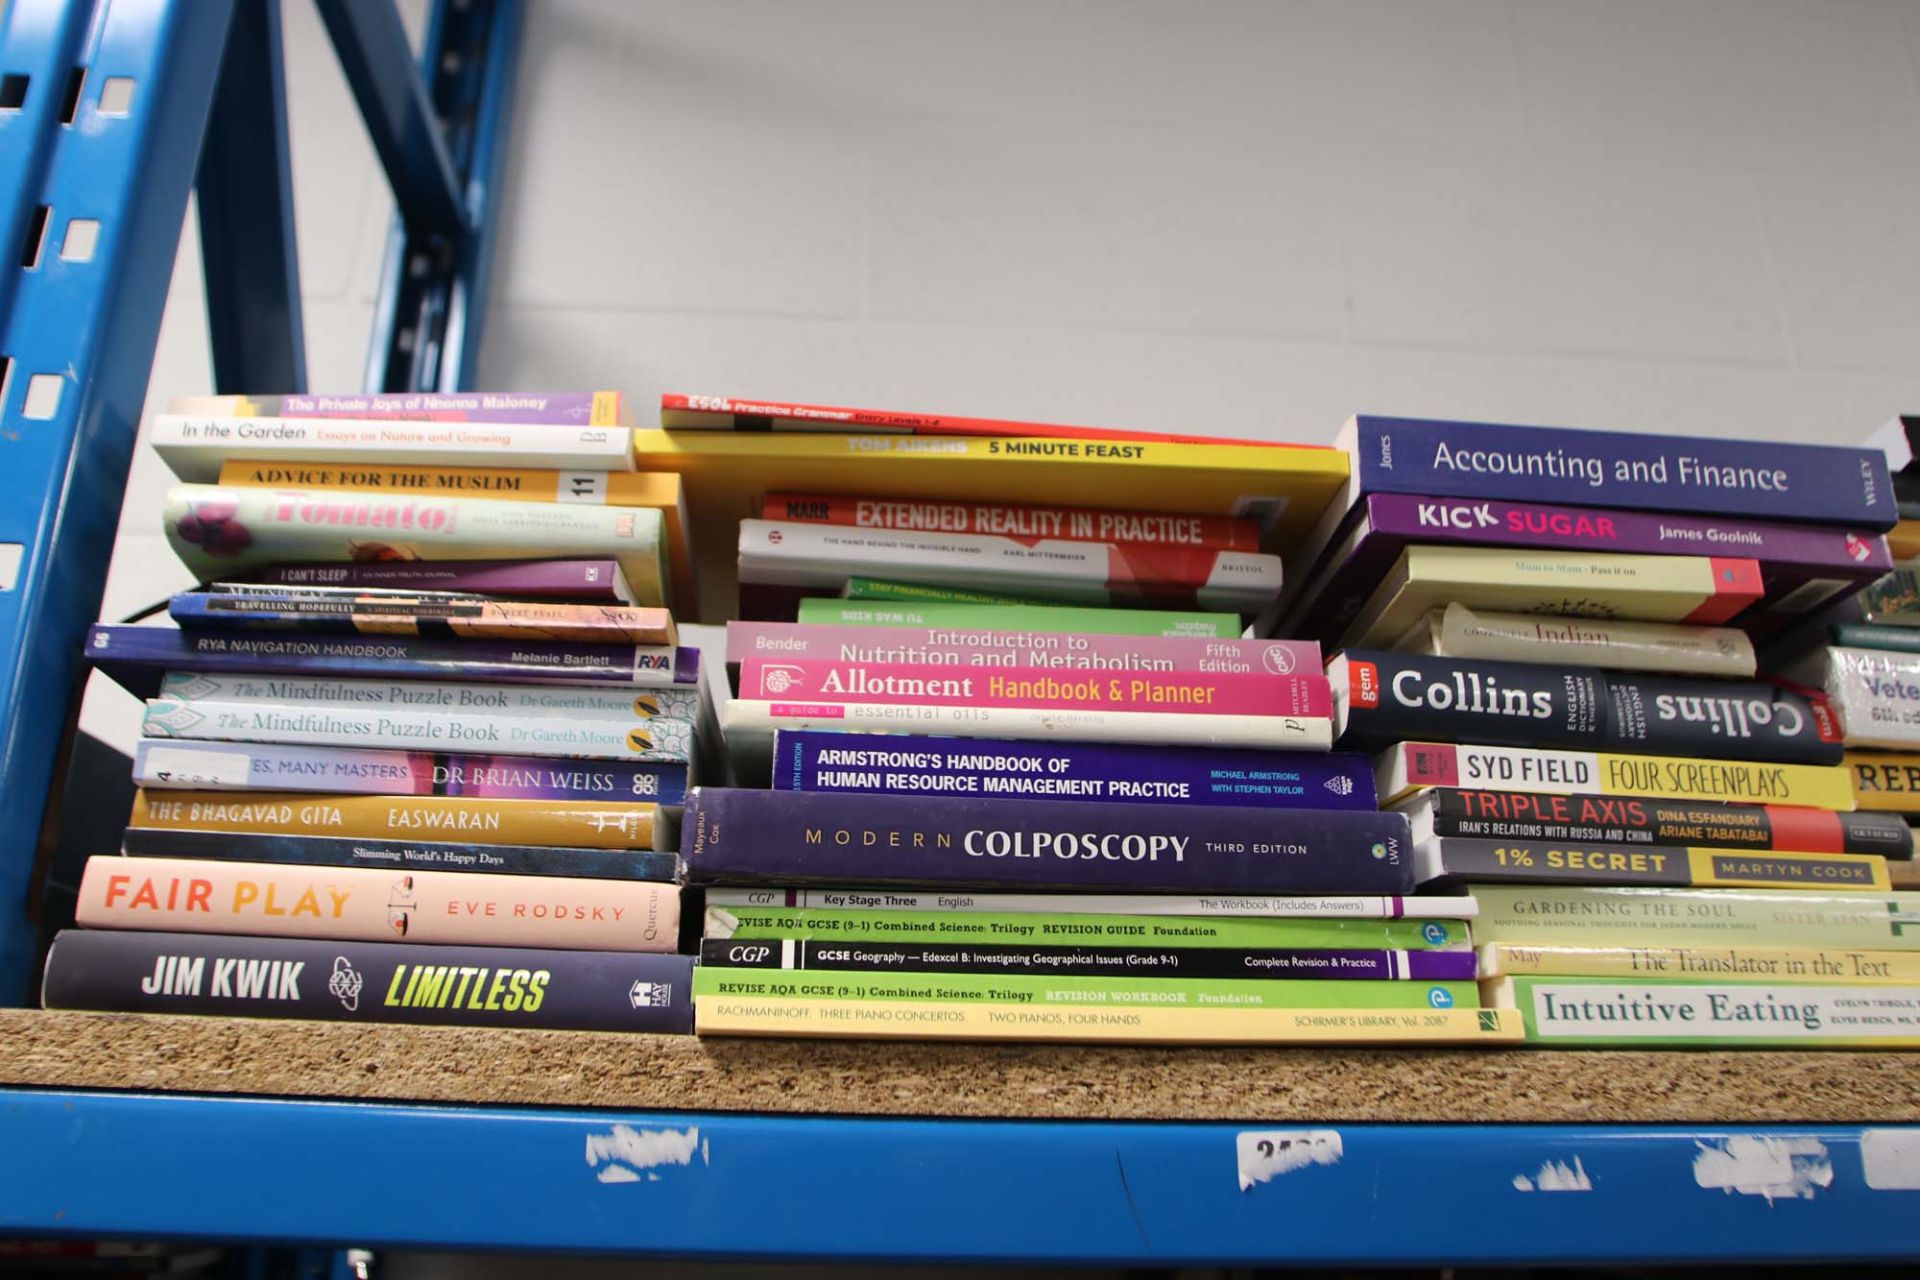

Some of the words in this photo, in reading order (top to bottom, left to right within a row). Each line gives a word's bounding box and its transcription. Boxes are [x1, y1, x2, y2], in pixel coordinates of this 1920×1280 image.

[288, 397, 316, 411] The
[319, 398, 368, 411] Private
[371, 398, 401, 412] Joys
[405, 397, 420, 410] of
[424, 397, 478, 411] Nnenna
[482, 396, 548, 412] Maloney
[688, 395, 731, 411] ESOL
[794, 407, 851, 420] Grammar
[1433, 442, 1603, 486] Accounting
[1615, 456, 1667, 483] and
[1678, 458, 1789, 491] Finance
[250, 470, 333, 485] ADVICE
[338, 471, 381, 487] FOR
[390, 473, 429, 487] THE
[436, 474, 521, 491] MUSLIM
[856, 502, 967, 530] EXTENDED
[975, 507, 1062, 536] REALITY
[1071, 511, 1092, 538] IN
[1100, 514, 1203, 544] PRACTICE
[1418, 503, 1499, 529] KICK
[1507, 510, 1617, 539] SUGAR
[1660, 524, 1703, 541] James
[1707, 528, 1762, 545] Goolnik
[235, 600, 294, 611] TRAVELLING
[299, 602, 355, 613] HOPEFULLY
[197, 639, 226, 651] RYA
[230, 641, 318, 655] NAVIGATION
[323, 644, 408, 658] HANDBOOK
[755, 637, 809, 651] Bender
[927, 629, 1066, 650] Introduction
[1068, 635, 1088, 650] to
[512, 652, 560, 663] Melanie
[564, 654, 609, 665] Bartlett
[840, 643, 959, 664] Nutrition
[970, 650, 1017, 668] and
[1029, 650, 1174, 672] Metabolism
[1206, 644, 1240, 658] Fifth
[637, 655, 670, 670] RYA
[1199, 659, 1250, 673] Edition
[234, 682, 262, 698] The
[266, 683, 383, 702] Mindfulness
[389, 688, 452, 706] Puzzle
[460, 689, 508, 708] Book
[519, 694, 532, 707] Dr
[536, 695, 584, 709] Gareth
[587, 698, 631, 710] Moore
[819, 668, 973, 697] Allotment
[989, 676, 1101, 701] Handbook
[1109, 679, 1123, 701] &
[1131, 681, 1215, 704] Planner
[1392, 670, 1553, 719] Collins
[855, 706, 940, 720] essential
[952, 709, 989, 721] oils
[1655, 694, 1804, 737] Collins
[278, 760, 328, 775] MANY
[334, 761, 407, 779] MASTERS
[817, 749, 942, 769] ARMSTRONG'S
[946, 754, 1043, 773] HANDBOOK
[1048, 758, 1070, 772] OF
[1467, 755, 1513, 779] SYD
[1522, 758, 1589, 784] FIELD
[432, 766, 464, 785] DR
[473, 767, 541, 788] BRIAN
[550, 771, 614, 791] WEISS
[817, 772, 880, 788] HUMAN
[885, 772, 977, 791] RESOURCE
[983, 776, 1103, 795] MANAGEMENT
[1109, 781, 1190, 798] PRACTICE
[1211, 770, 1247, 780] MICHAEL
[1248, 770, 1300, 782] ARMSTRONG
[1609, 759, 1663, 793] FOUR
[1668, 764, 1790, 799] SCREENPLAYS
[1211, 783, 1231, 793] WITH
[1234, 784, 1271, 794] STEPHEN
[1273, 785, 1304, 795] TAYLOR
[150, 801, 181, 821] THE
[190, 802, 291, 824] BHAGAVAD
[300, 806, 342, 825] GITA
[388, 808, 500, 829] EASWARAN
[1458, 791, 1571, 822] TRIPLE
[1581, 797, 1649, 825] AXIS
[1657, 810, 1686, 822] DINA
[1689, 811, 1760, 826] ESFANDIARY
[1459, 821, 1490, 834] IRAN'S
[1492, 822, 1541, 837] RELATIONS
[1545, 825, 1567, 838] WITH
[1570, 825, 1603, 840] RUSSIA
[1605, 829, 1625, 841] AND
[1626, 830, 1654, 842] CHINA
[353, 847, 401, 861] Slimming
[404, 850, 441, 862] World's
[444, 851, 478, 865] Happy
[479, 853, 504, 865] Days
[806, 831, 951, 848] MODERN
[963, 830, 1190, 862] COLPOSCOPY
[1206, 843, 1245, 853] THIRD
[1253, 844, 1307, 855] EDITION
[1389, 837, 1399, 865] LWW
[1494, 848, 1534, 866] 1%
[1547, 850, 1666, 872] SECRET
[1721, 862, 1802, 876] MARTYN
[1812, 866, 1864, 878] COOK
[105, 876, 213, 912] FAIR
[232, 882, 356, 918] PLAY
[824, 894, 845, 906] Key
[849, 894, 881, 906] Stage
[885, 895, 917, 906] Three
[938, 897, 974, 908] English
[447, 901, 497, 917] EVE
[514, 904, 625, 921] RODSKY
[1513, 901, 1631, 917] GARDENING
[1642, 904, 1679, 916] THE
[1687, 905, 1736, 917] SOUL
[808, 920, 839, 930] GCSE
[874, 922, 935, 932] Combined
[991, 924, 1034, 936] Trilogy
[1043, 925, 1106, 935] REVISION
[1107, 926, 1146, 935] GUIDE
[1153, 926, 1217, 936] Foundation
[729, 946, 769, 962] CGP
[818, 951, 850, 961] GCSE
[853, 951, 904, 964] Geography
[922, 952, 958, 963] Edexcel
[961, 953, 971, 962] B:
[973, 953, 1030, 965] Investigating
[1032, 954, 1093, 966] Geographical
[1096, 955, 1123, 965] Issues
[1126, 955, 1158, 966] (Grade
[1161, 955, 1178, 966] 9-1)
[1245, 956, 1289, 968] Complete
[1292, 957, 1329, 968] Revision
[1331, 958, 1338, 967] &
[1341, 958, 1376, 968] Practice
[1631, 947, 1671, 971] The
[1672, 949, 1777, 975] Translator
[1787, 952, 1806, 975] in
[1812, 952, 1843, 976] the
[1852, 954, 1891, 977] Text
[141, 955, 205, 996] JIM
[210, 958, 305, 1000] KWIK
[384, 964, 551, 1012] LIMITLESS
[819, 1008, 852, 1020] THREE
[855, 1009, 892, 1020] PIANO
[989, 1012, 1016, 1022] TWO
[1019, 1013, 1065, 1024] PIANOS,
[1068, 1014, 1098, 1024] FOUR
[1101, 1015, 1140, 1025] HANDS
[1541, 992, 1695, 1021] Intuitive
[1706, 994, 1820, 1030] Eating
